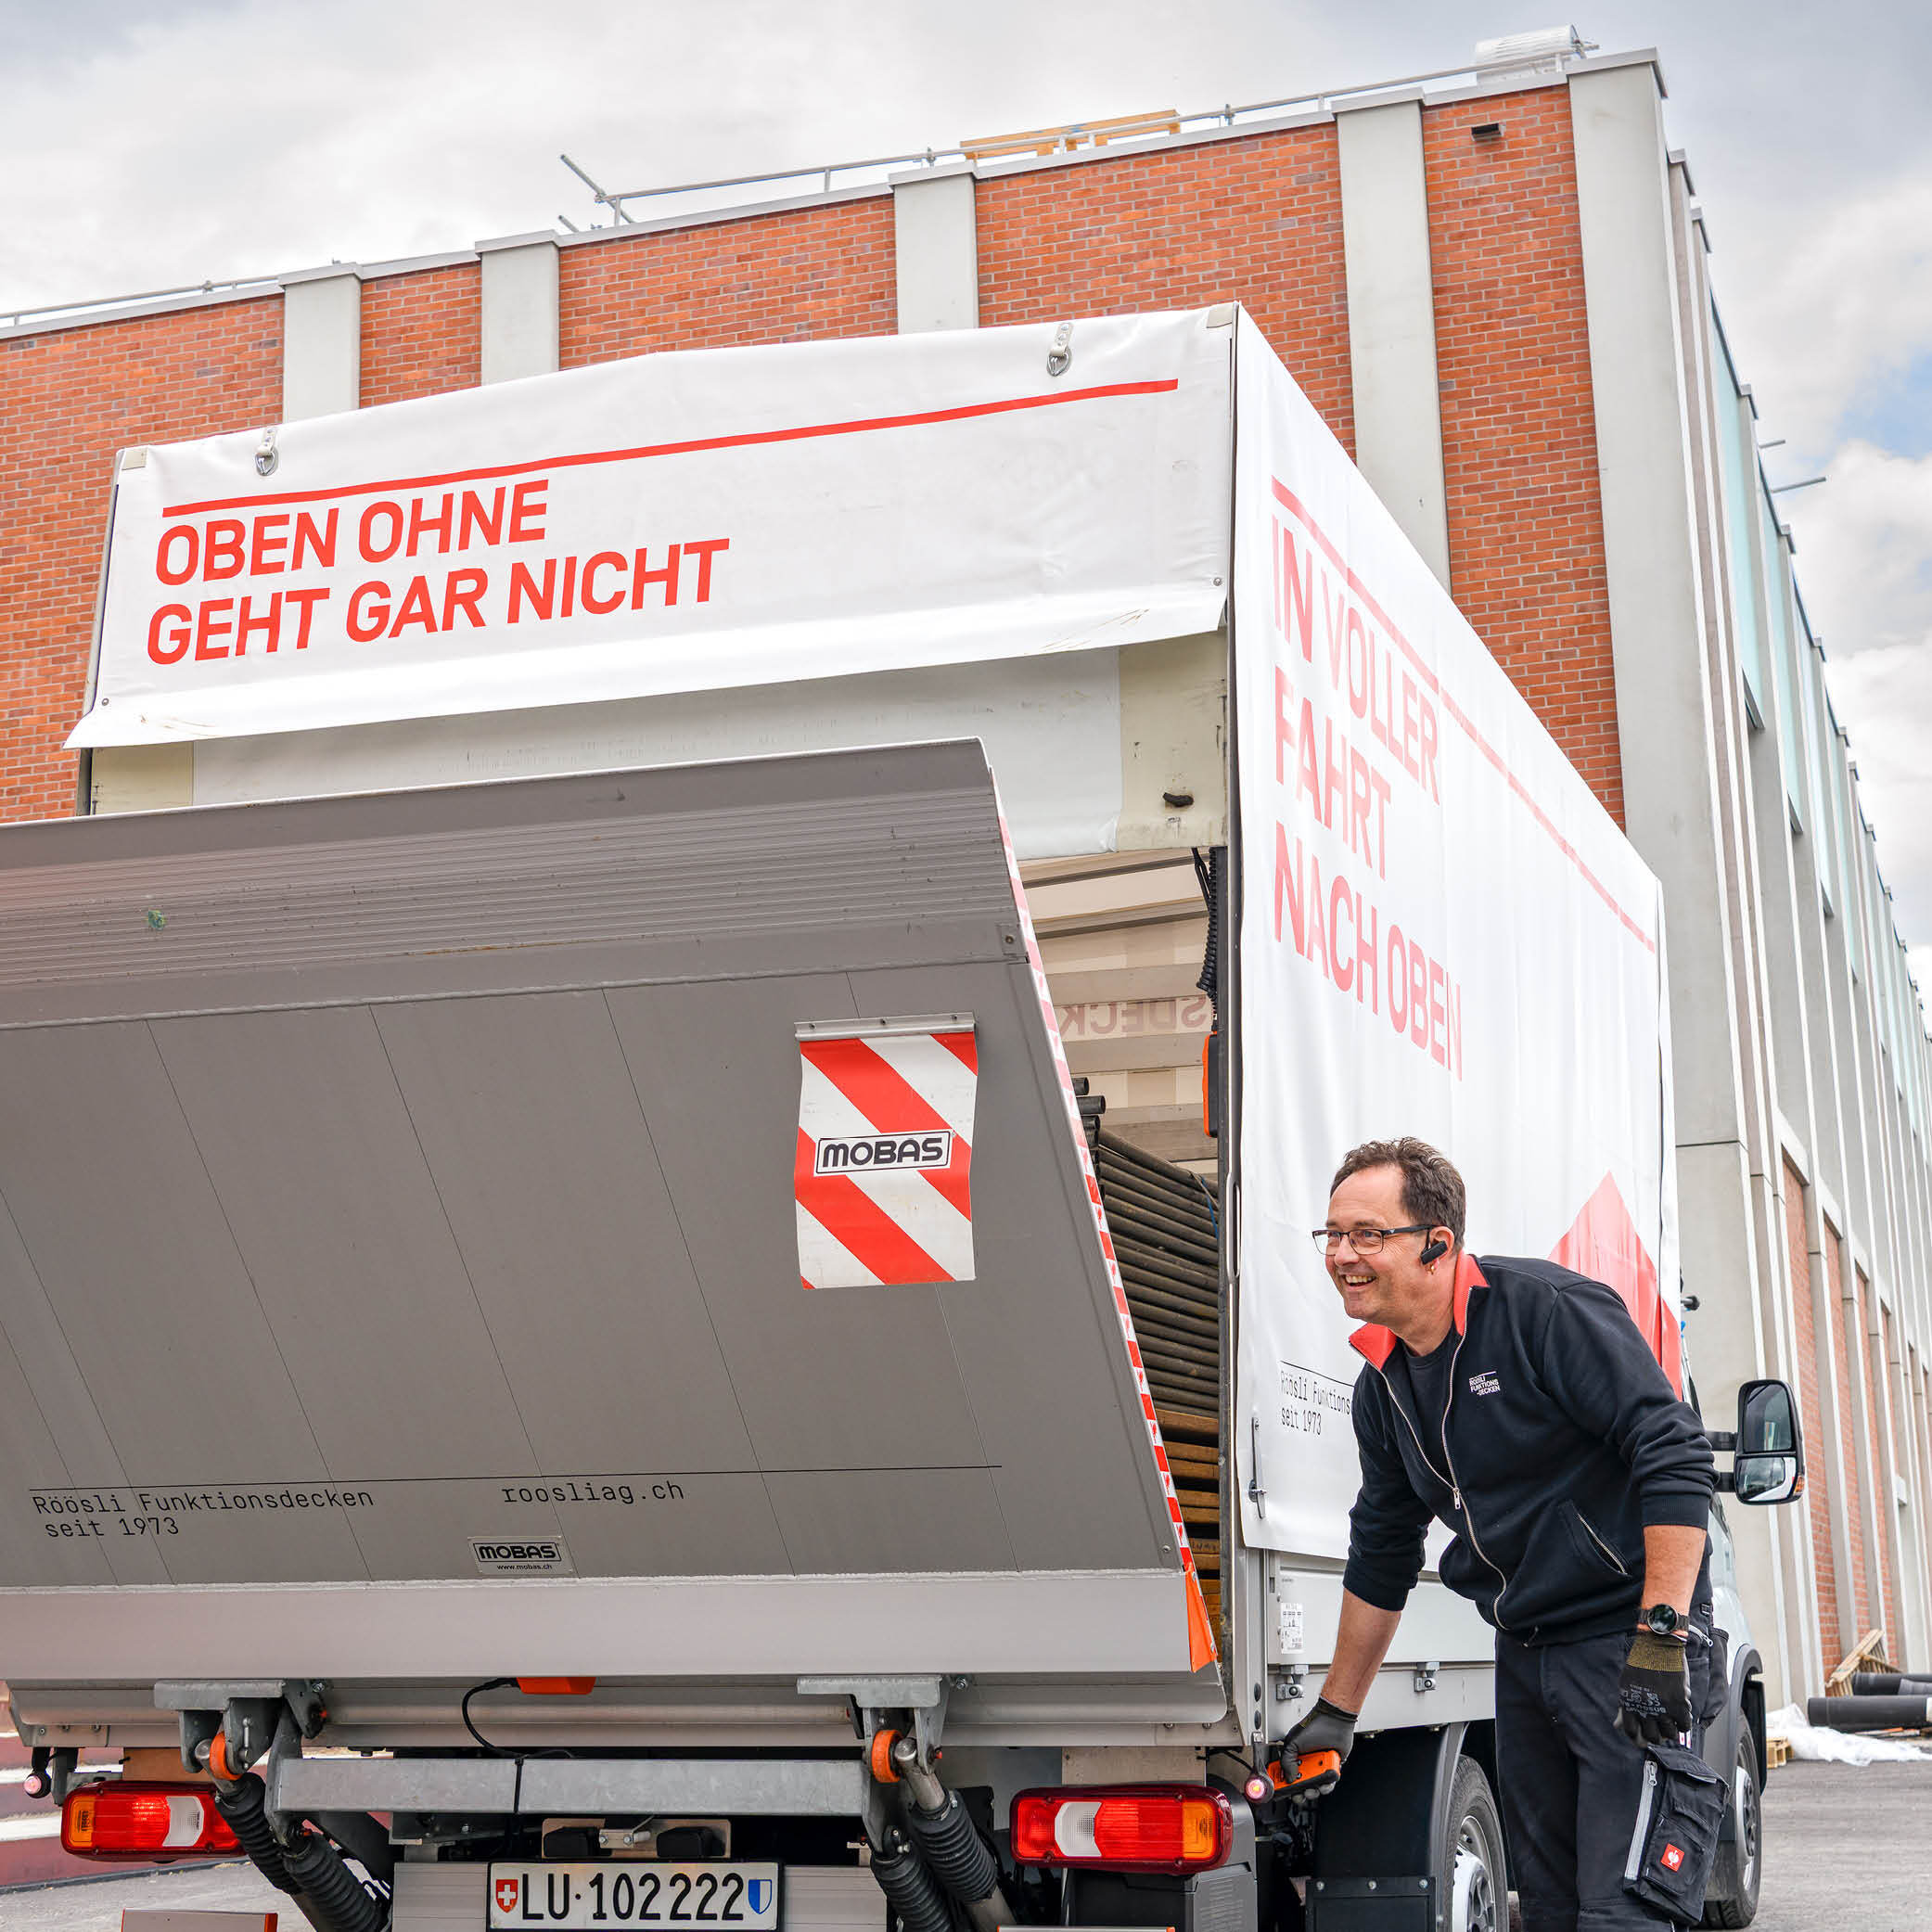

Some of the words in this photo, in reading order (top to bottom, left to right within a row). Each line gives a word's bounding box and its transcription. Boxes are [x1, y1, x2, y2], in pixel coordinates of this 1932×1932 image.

[156, 507, 339, 586] OBEN
[358, 479, 549, 563] OHNE
[147, 587, 330, 665] GEHT
[346, 568, 488, 643] GAR
[507, 538, 730, 623] NICHT
[1272, 514, 1312, 663] IN
[1321, 568, 1440, 806] VOLLER
[1274, 665, 1392, 880] FAHRT
[1274, 821, 1378, 1016] NACH
[1388, 924, 1463, 1081] OBEN
[822, 1137, 943, 1168] MOBAS
[1281, 1370, 1308, 1401] Röösli
[1312, 1381, 1350, 1415] Funktions
[1282, 1405, 1299, 1429] seit
[1303, 1410, 1322, 1435] 1973
[32, 1494, 126, 1515] Röösli
[139, 1489, 375, 1512] Funktionsdecken
[502, 1480, 685, 1504] roosliag.ch
[45, 1519, 105, 1538] seit
[119, 1517, 179, 1535] 1973
[479, 1545, 557, 1559] MOBAS
